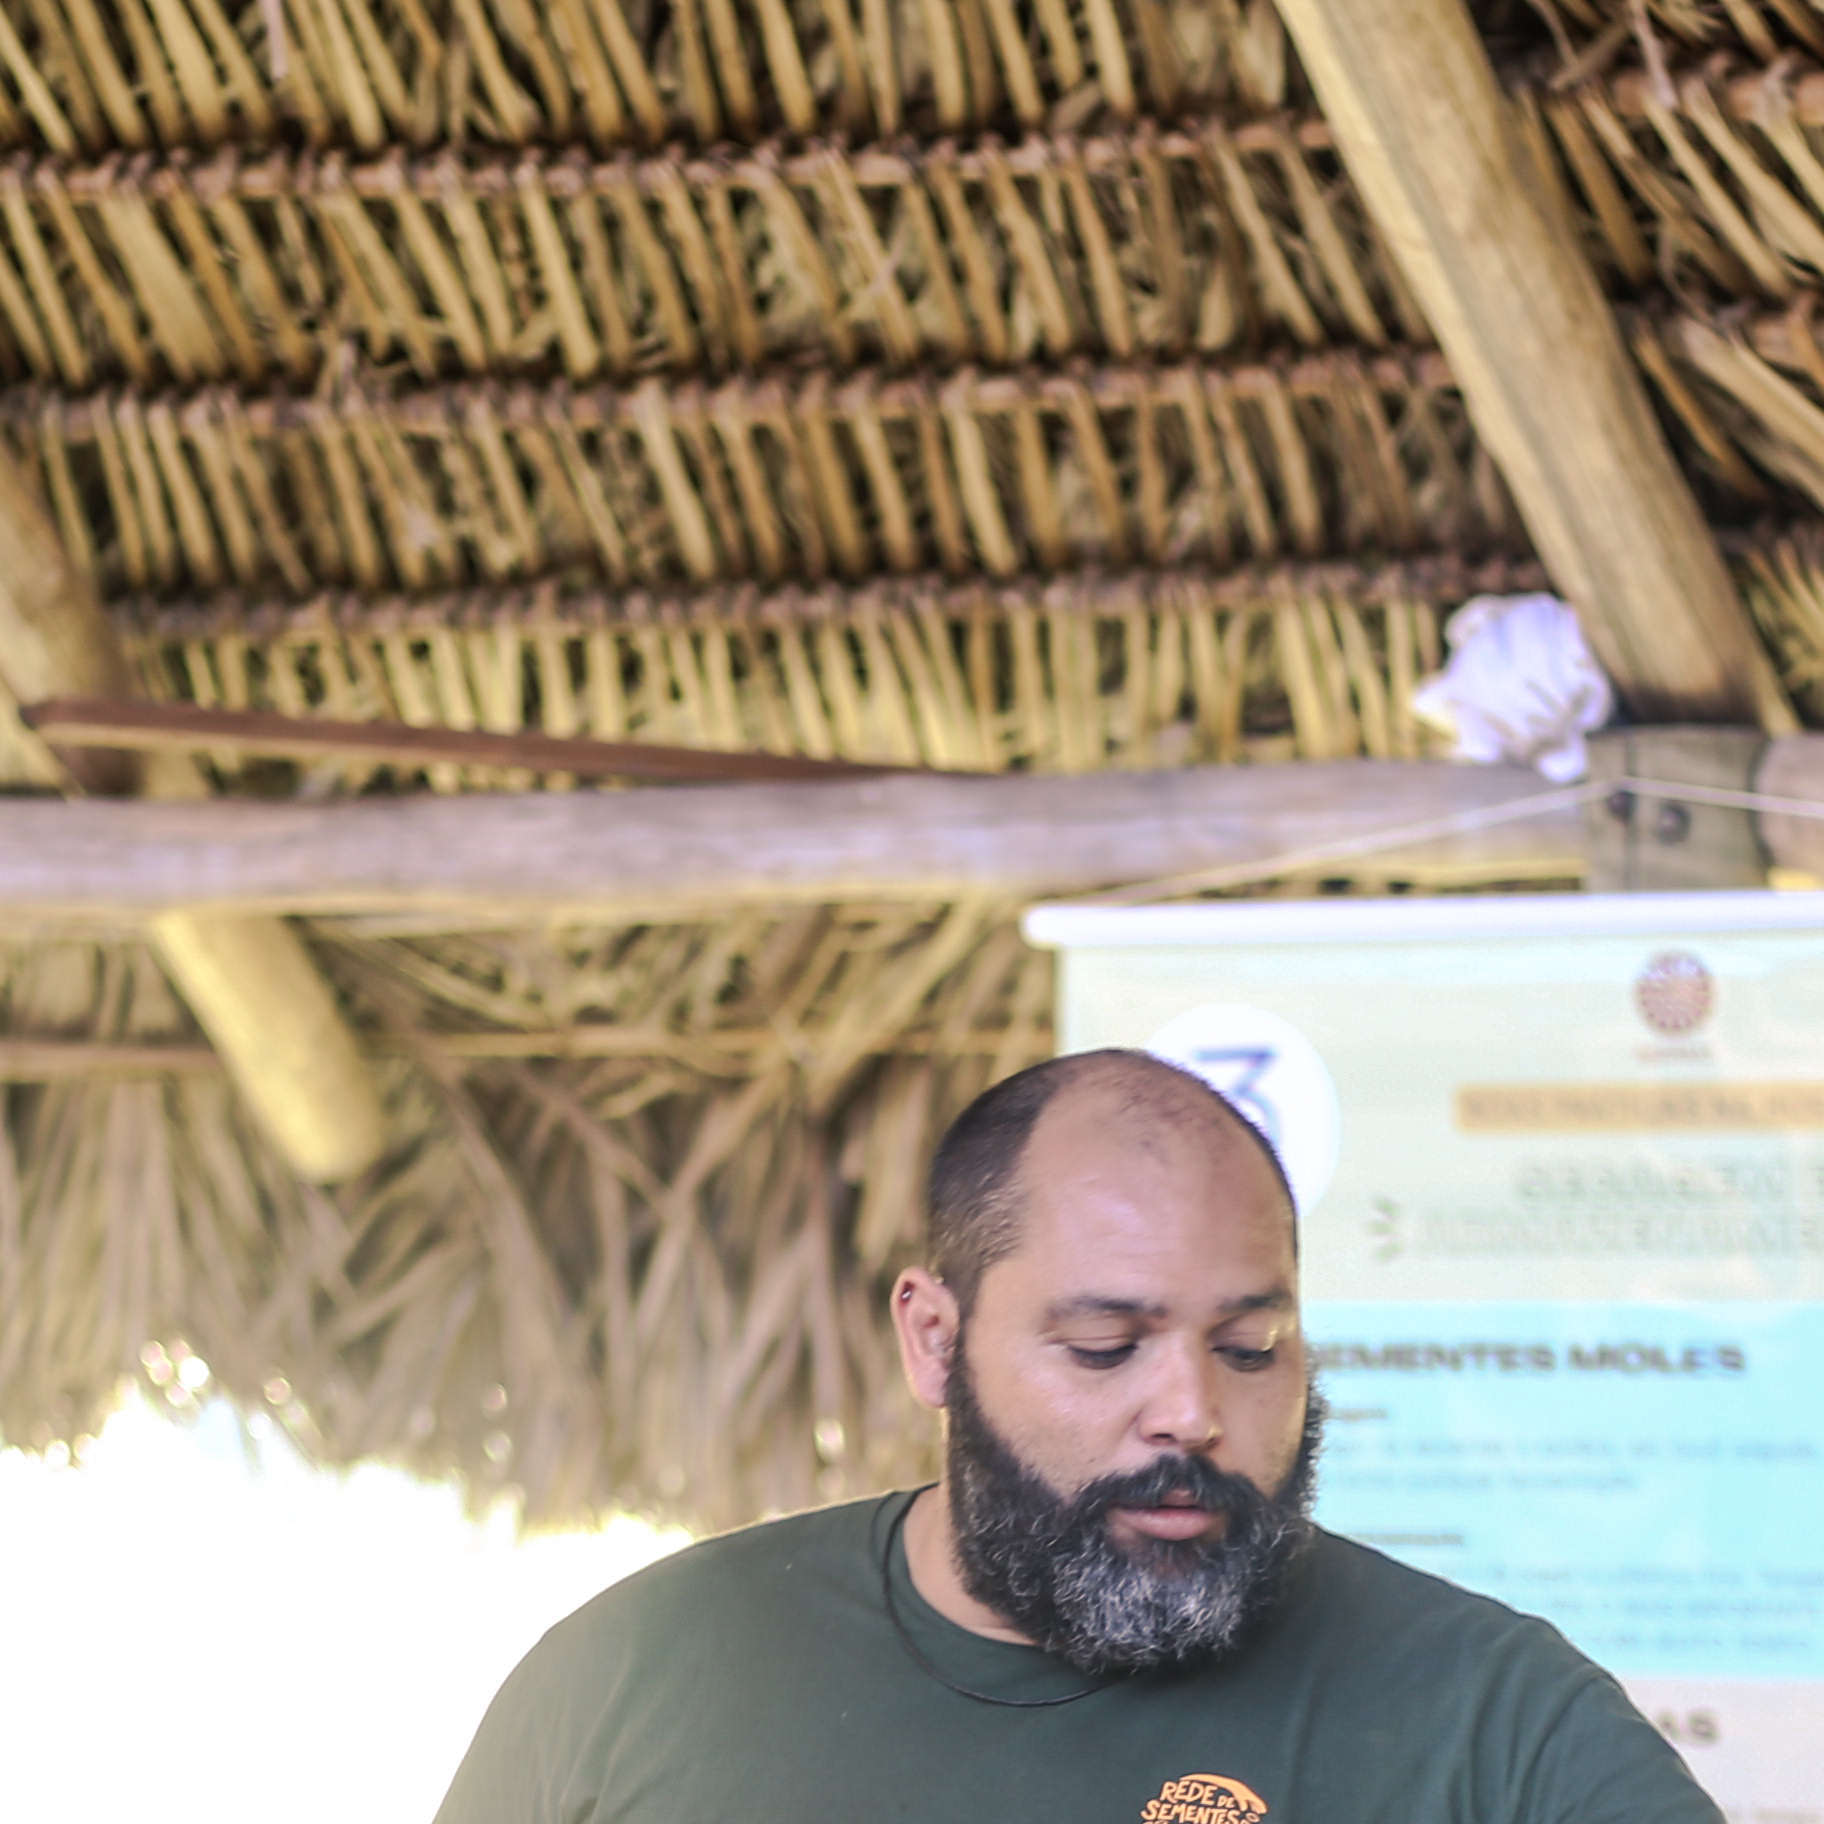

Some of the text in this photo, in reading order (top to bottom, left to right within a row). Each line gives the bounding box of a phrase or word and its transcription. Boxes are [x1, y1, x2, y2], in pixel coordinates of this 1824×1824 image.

[1568, 1341, 1747, 1373] MOLES
[1159, 1781, 1236, 1808] REDE DE
